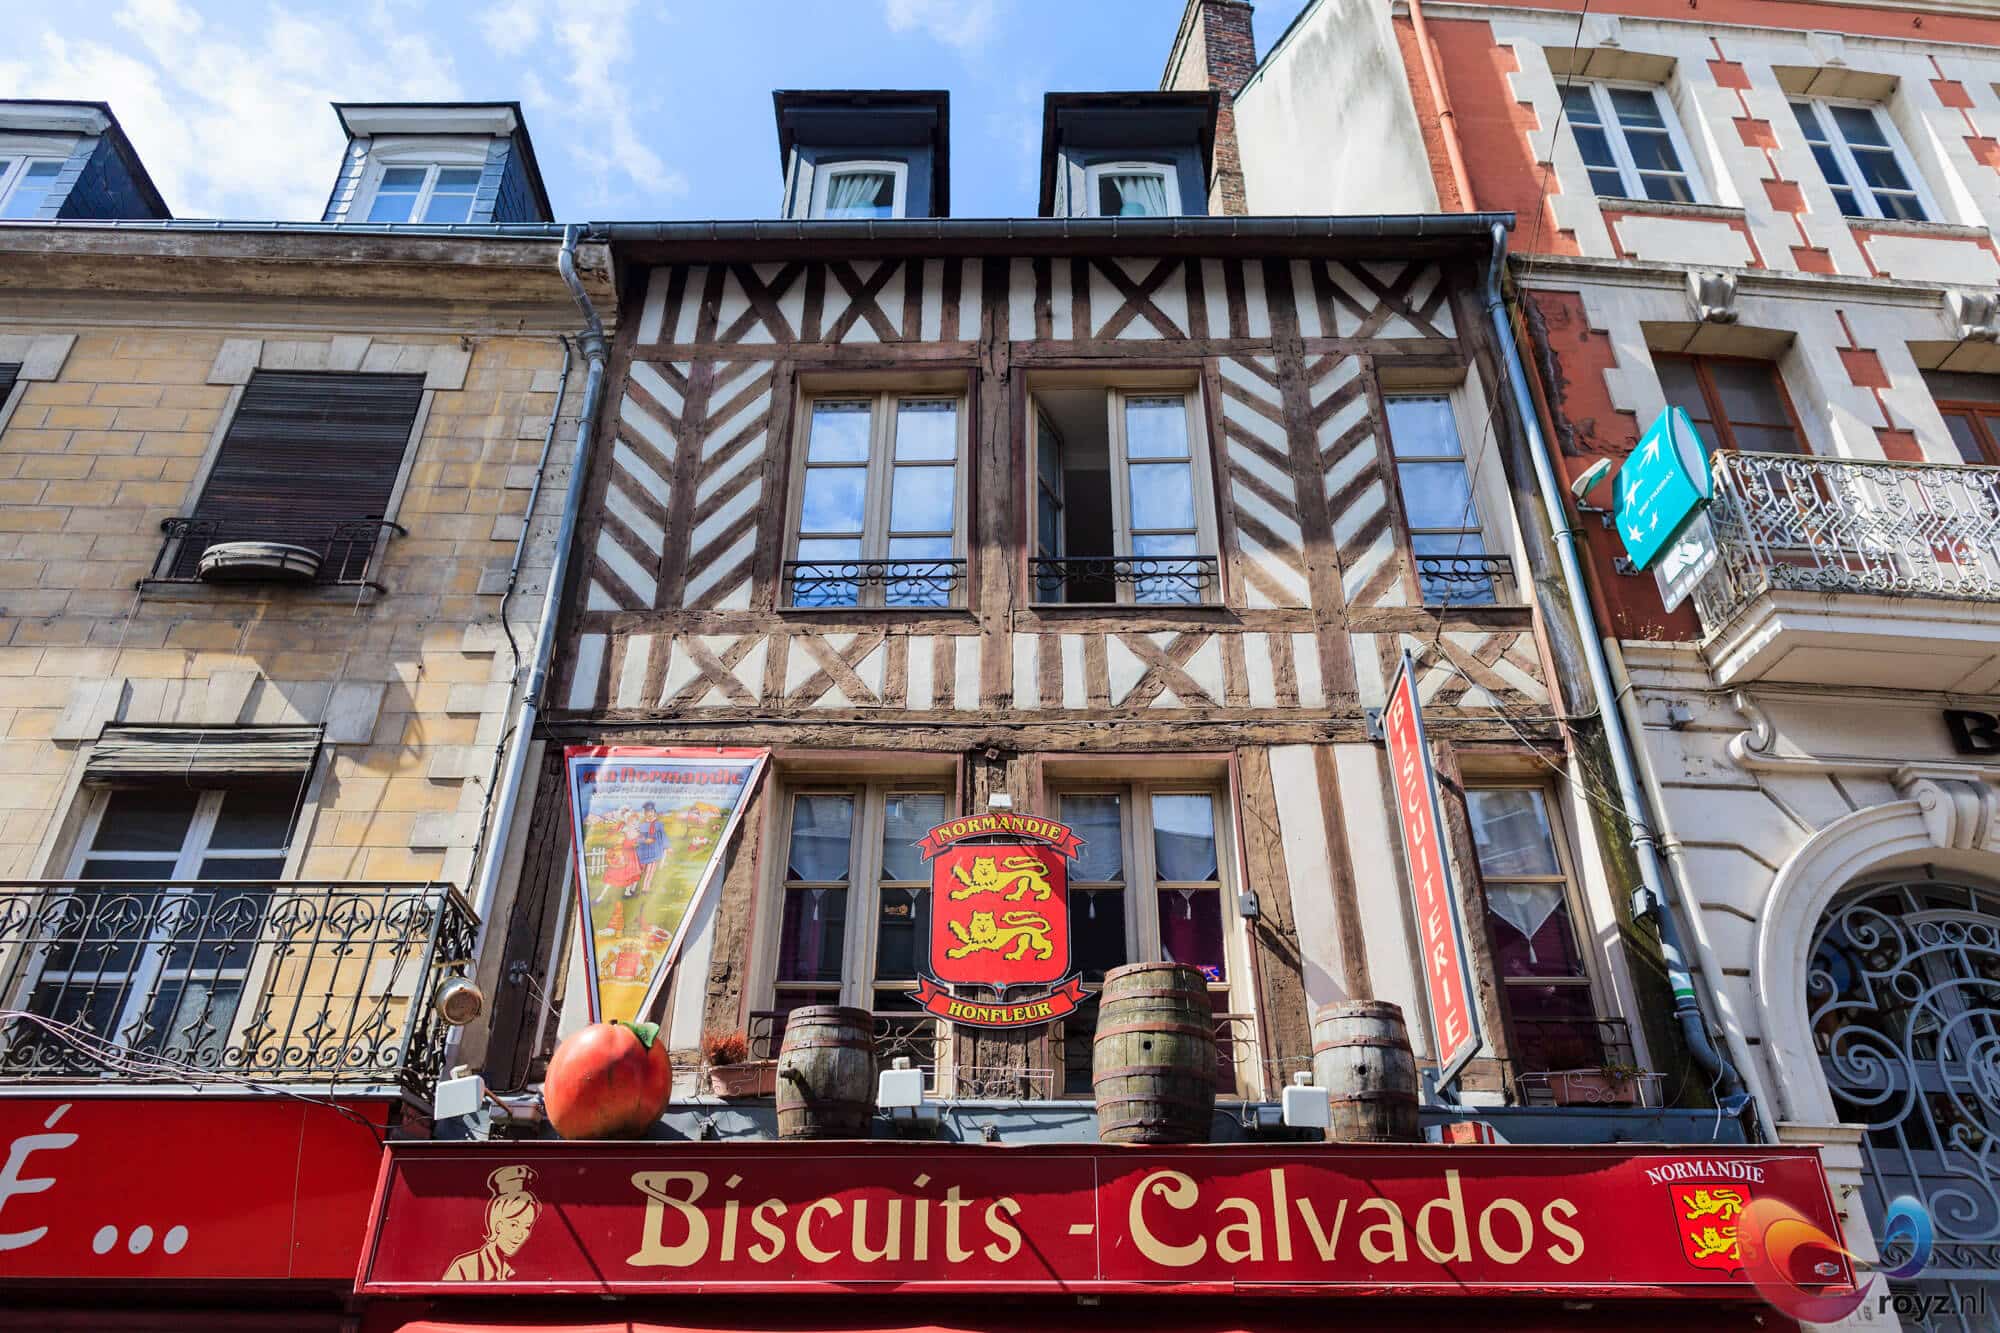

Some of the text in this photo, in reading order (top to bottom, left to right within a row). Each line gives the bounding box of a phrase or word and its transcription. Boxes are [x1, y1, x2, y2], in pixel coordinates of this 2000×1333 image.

[938, 815, 1062, 843] NORMANDIE
[1391, 696, 1459, 1046] BISCUITERIE
[948, 1002, 1053, 1023] HONFLEUR
[1645, 1160, 1765, 1186] NORMANDIE
[625, 1170, 1023, 1268] Biscuits
[1128, 1168, 1585, 1268] Calvados
